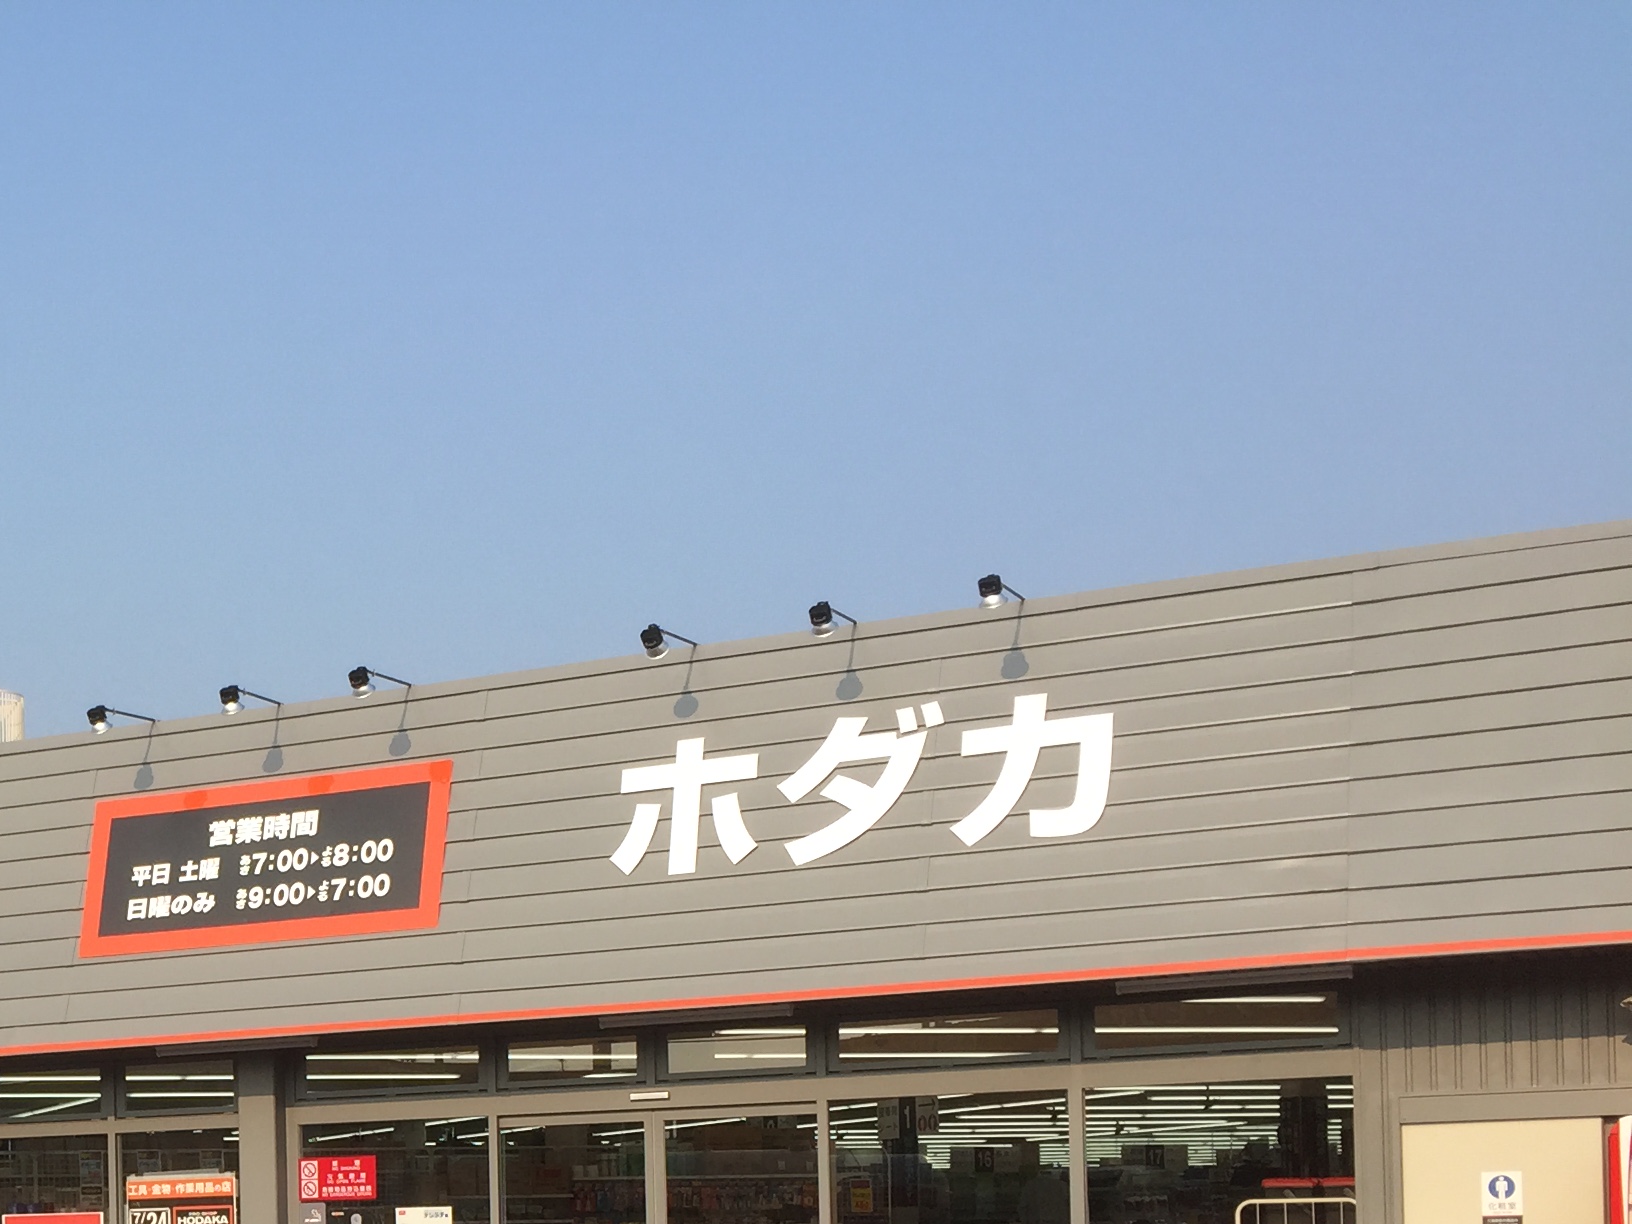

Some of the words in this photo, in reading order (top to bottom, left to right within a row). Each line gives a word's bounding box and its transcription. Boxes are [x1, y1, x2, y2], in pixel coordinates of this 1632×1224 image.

[608, 693, 1115, 876] ホダカ
[208, 810, 320, 847] 営業時間
[131, 863, 171, 887] 平日
[178, 857, 221, 882] 土曜
[127, 891, 217, 920] 日曜のみ
